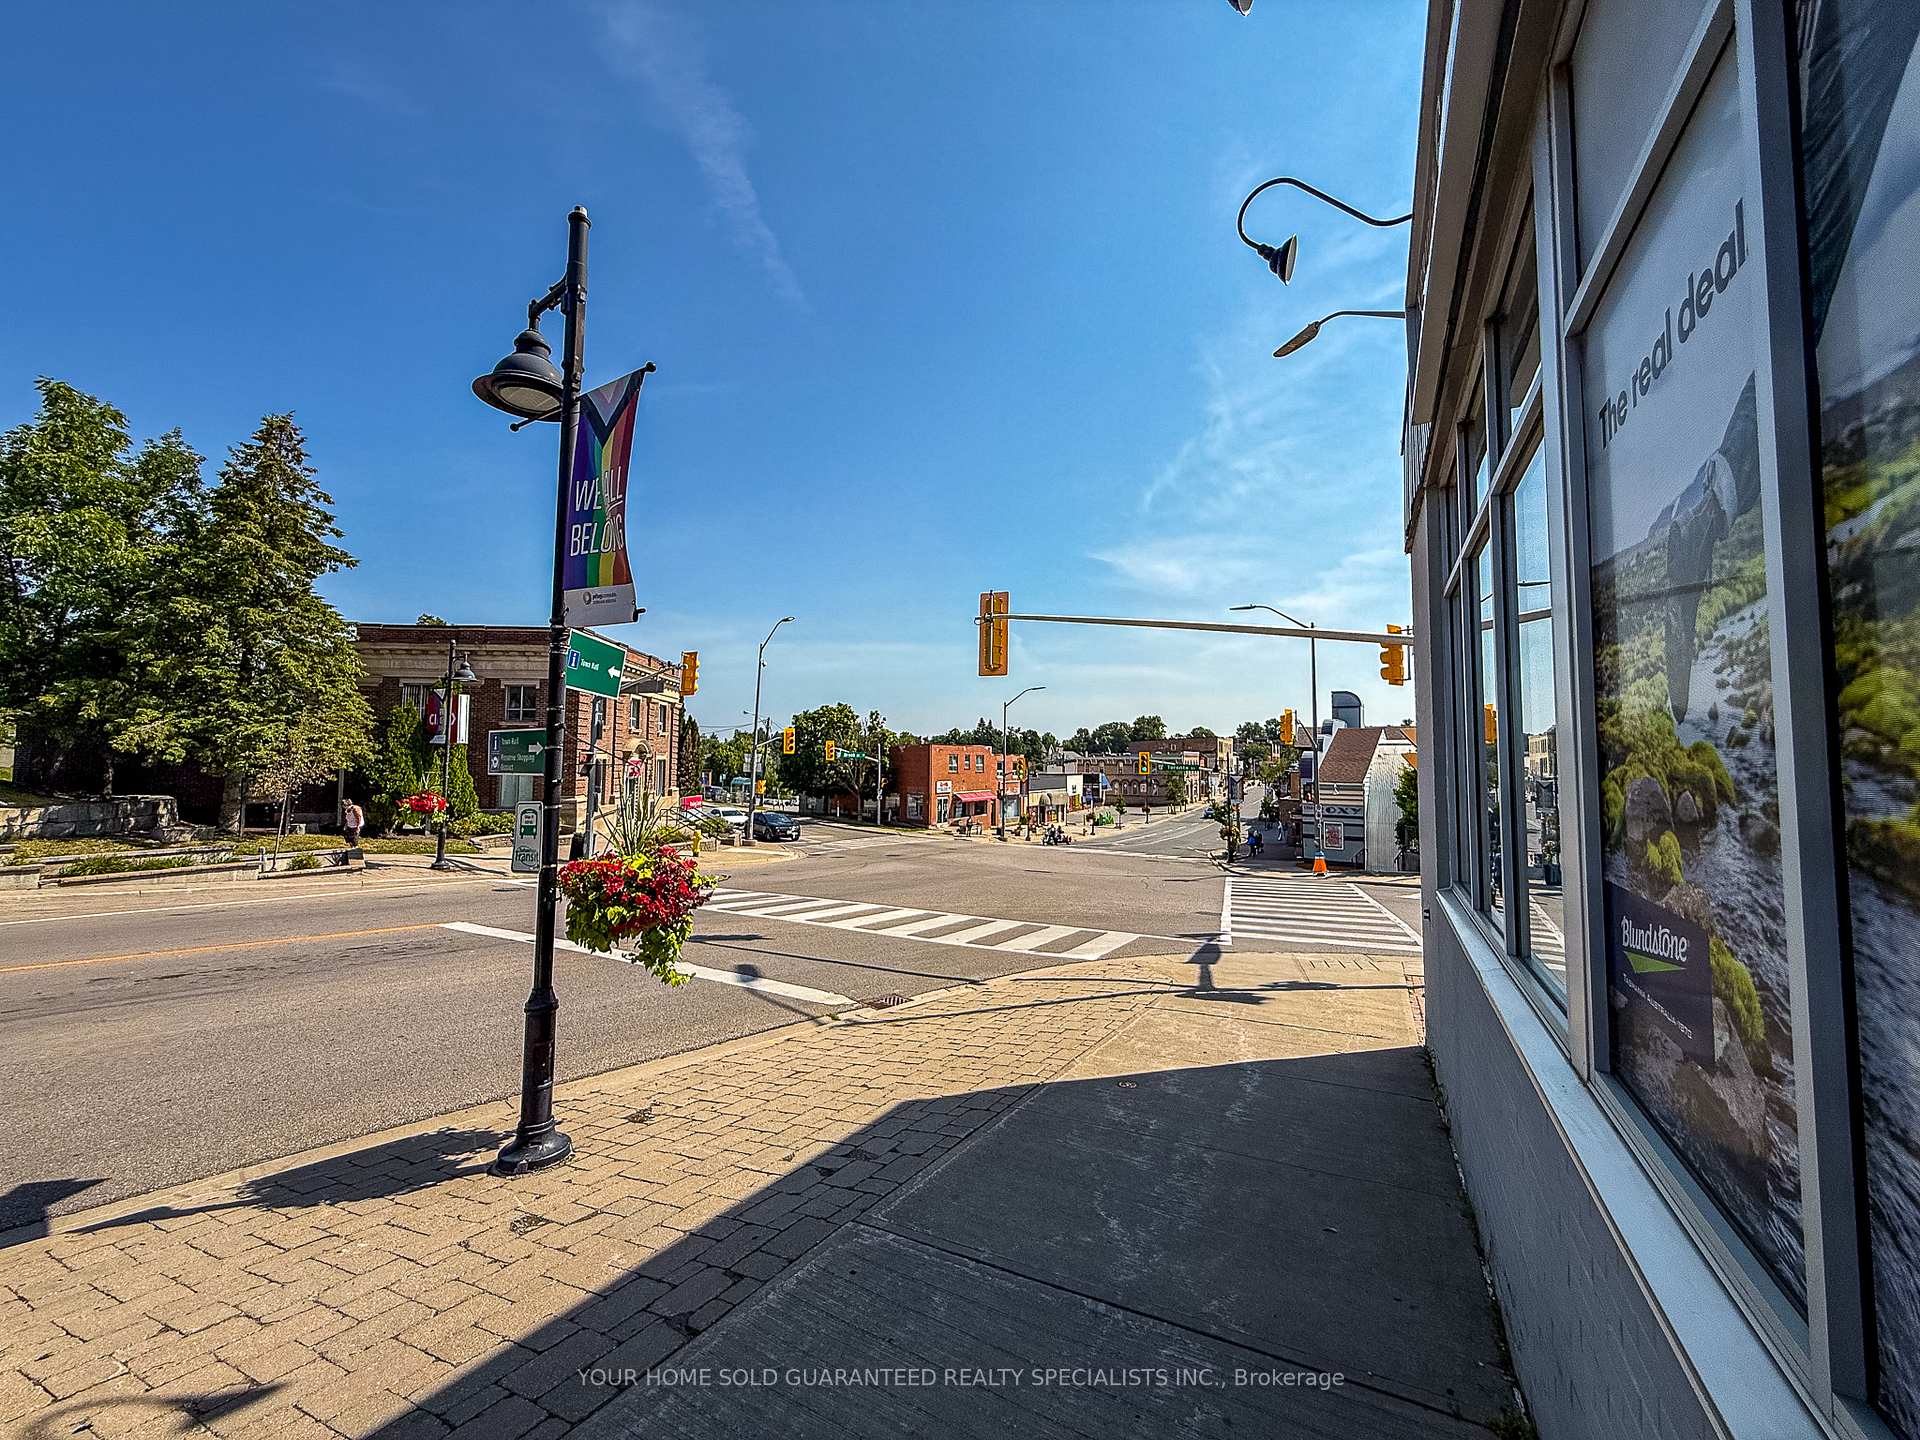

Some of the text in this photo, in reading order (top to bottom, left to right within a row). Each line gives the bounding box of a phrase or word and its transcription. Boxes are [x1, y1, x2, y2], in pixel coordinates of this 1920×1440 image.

[1599, 391, 1628, 450] The
[1632, 306, 1672, 408] real
[575, 466, 623, 512] WE ALL
[570, 513, 624, 557] BELONG
[1321, 806, 1362, 816] OXY
[1621, 915, 1688, 963] Blundstone
